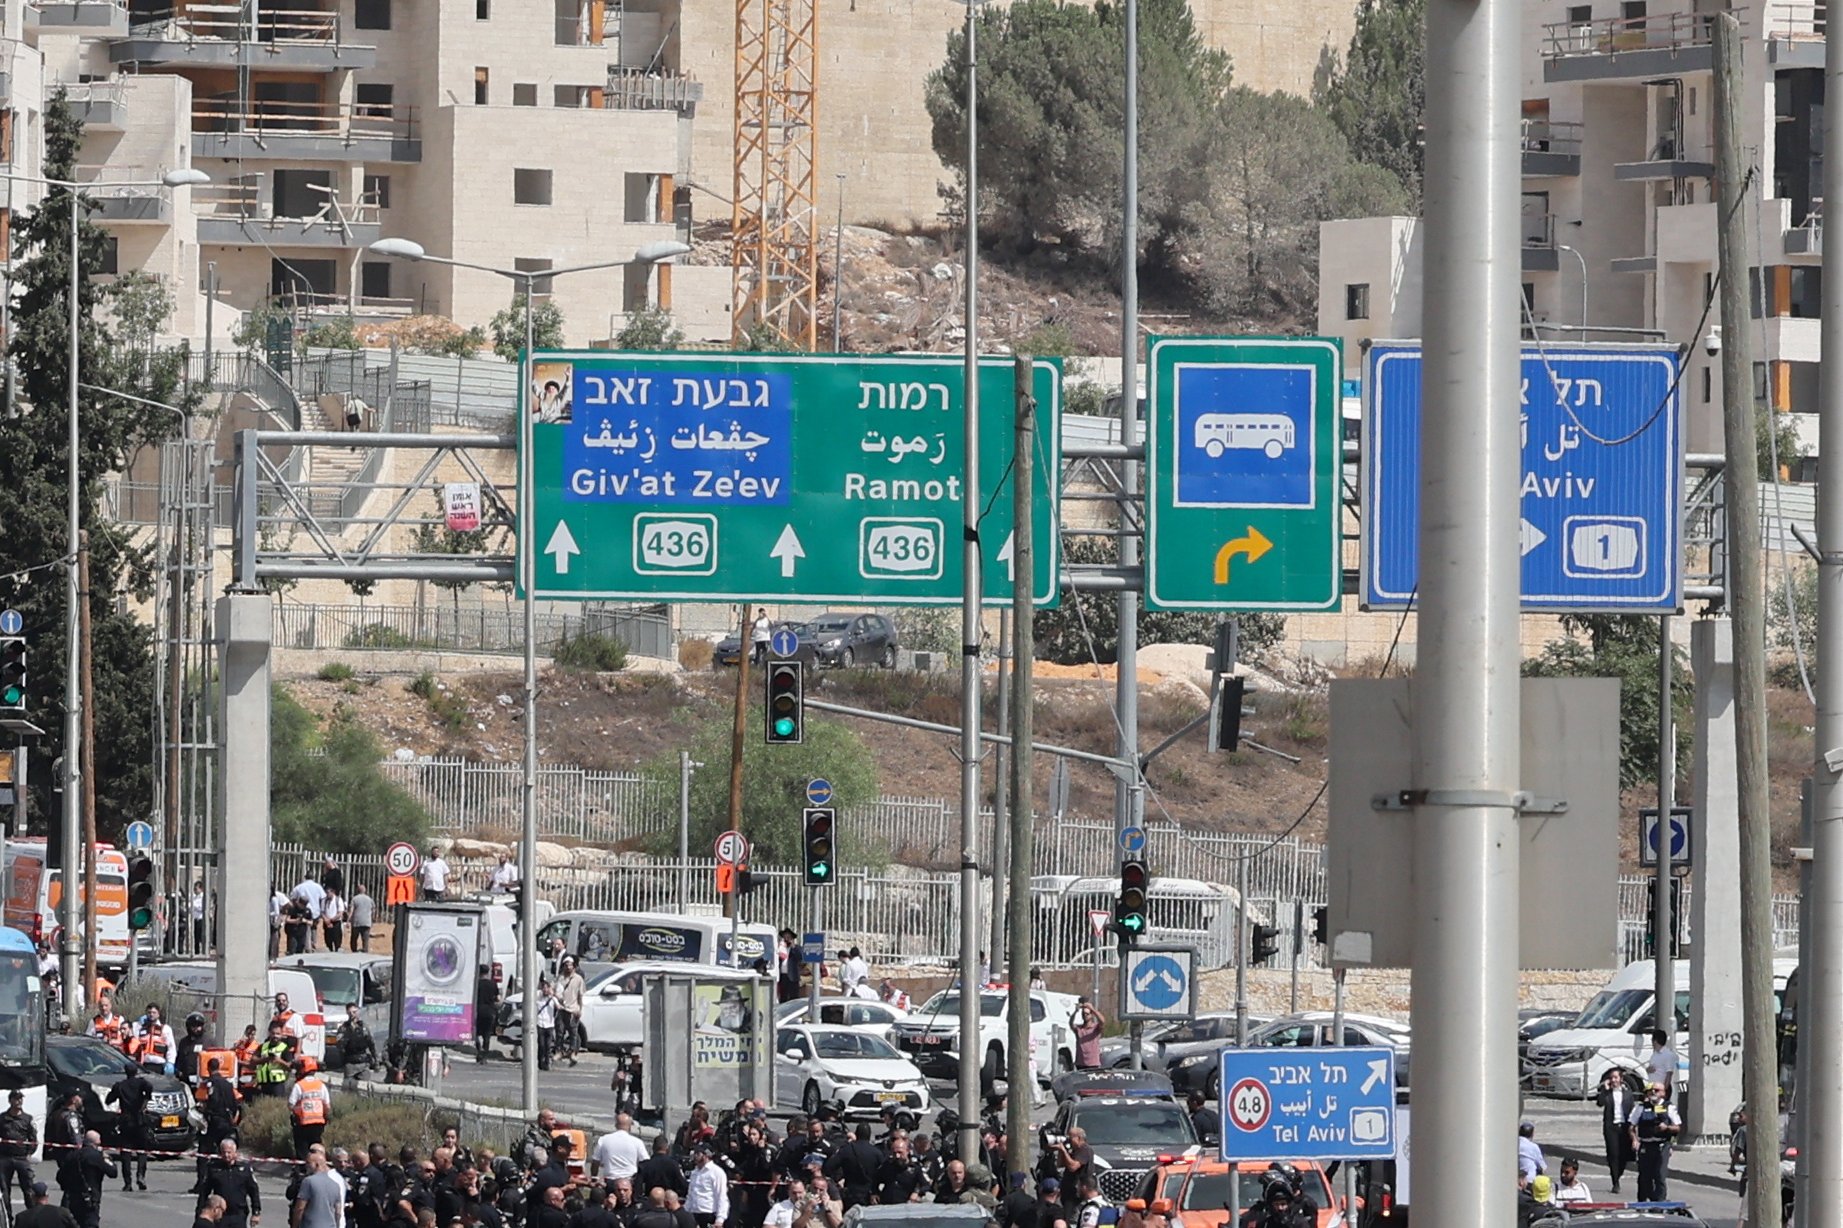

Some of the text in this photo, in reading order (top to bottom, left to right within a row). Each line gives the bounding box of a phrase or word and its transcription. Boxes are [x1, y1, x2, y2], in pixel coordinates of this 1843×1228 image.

[585, 375, 770, 408] גבעת זאב
[858, 381, 950, 411] רמות
[1556, 371, 1601, 406] תל
[1543, 425, 1580, 462] تل
[572, 468, 780, 499] Giv'at Ze'ev
[845, 473, 960, 501] Ramot
[1521, 474, 1595, 499] Aviv
[647, 531, 704, 558] 436
[873, 535, 930, 562] 436
[1597, 535, 1610, 559] 1
[392, 854, 413, 867] 50
[696, 1035, 736, 1048] המלך
[1269, 1061, 1347, 1084] תל אביב
[1238, 1096, 1262, 1113] 4.8
[1280, 1089, 1338, 1119] تل أبيب
[1272, 1122, 1346, 1143] Tel Aviv
[1366, 1118, 1373, 1134] 1
